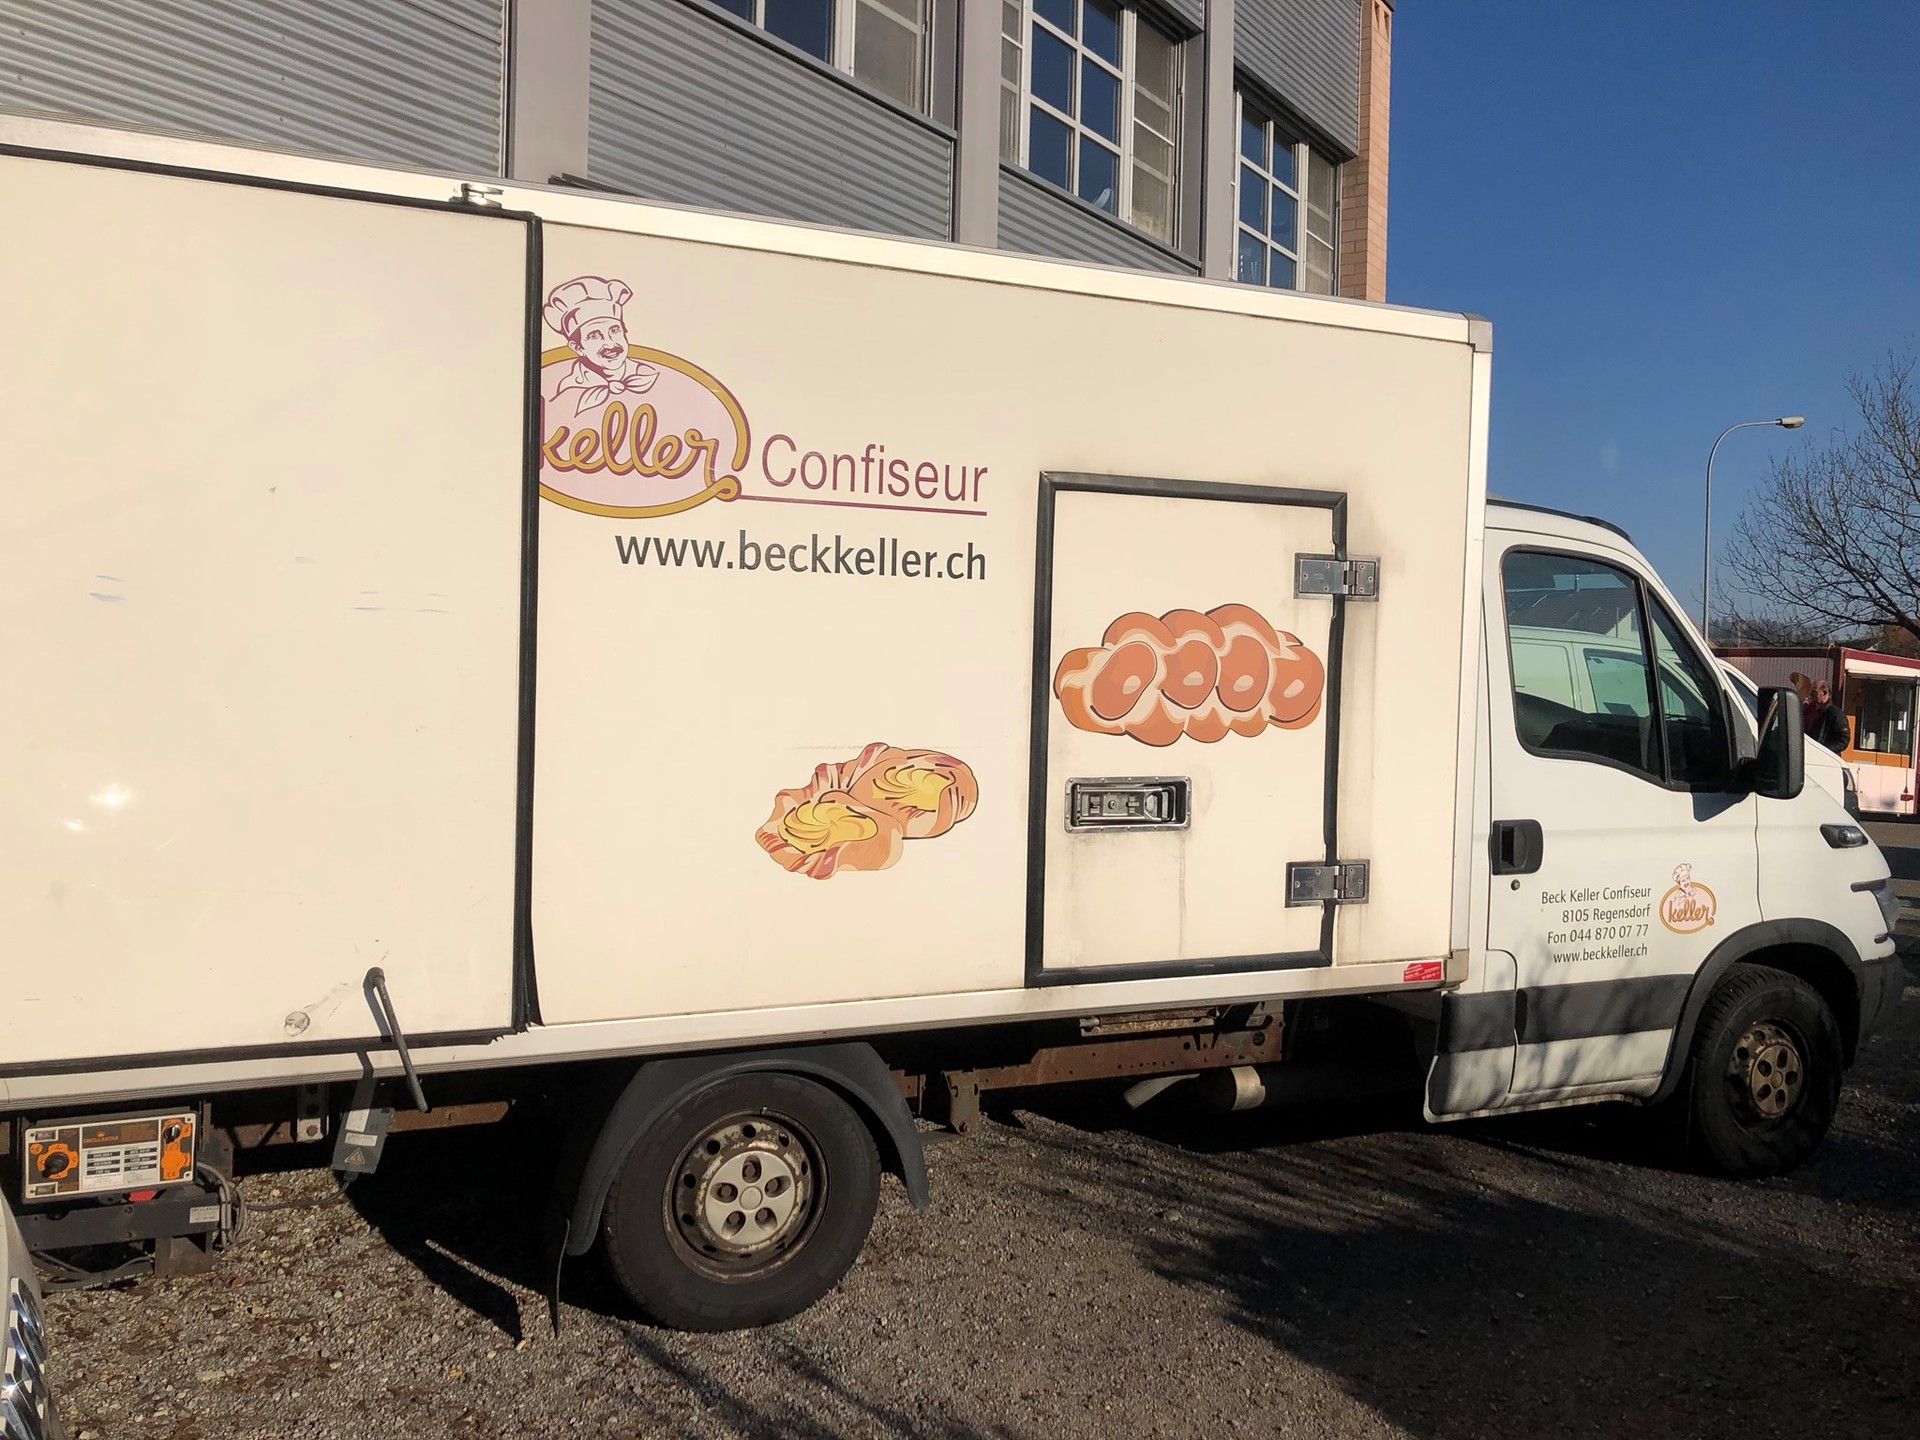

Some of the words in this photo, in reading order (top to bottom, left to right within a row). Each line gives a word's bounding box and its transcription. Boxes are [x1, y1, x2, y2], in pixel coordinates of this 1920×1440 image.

[540, 395, 719, 486] keller
[761, 433, 989, 502] Confiseur
[615, 529, 987, 580] www.beckkeller.ch
[1541, 889, 1566, 904] Beck
[1570, 888, 1600, 902] Keller
[1603, 885, 1651, 900] Confiseur
[1562, 909, 1589, 923] 8105
[1593, 903, 1651, 923] Regensdorf
[1668, 899, 1710, 923] keller
[1547, 931, 1566, 944] Fon
[1570, 929, 1591, 942] 044
[1595, 926, 1616, 940] 870
[1619, 925, 1632, 938] 07
[1636, 924, 1649, 937] 77
[1553, 943, 1648, 963] www.beckkeller.ch
